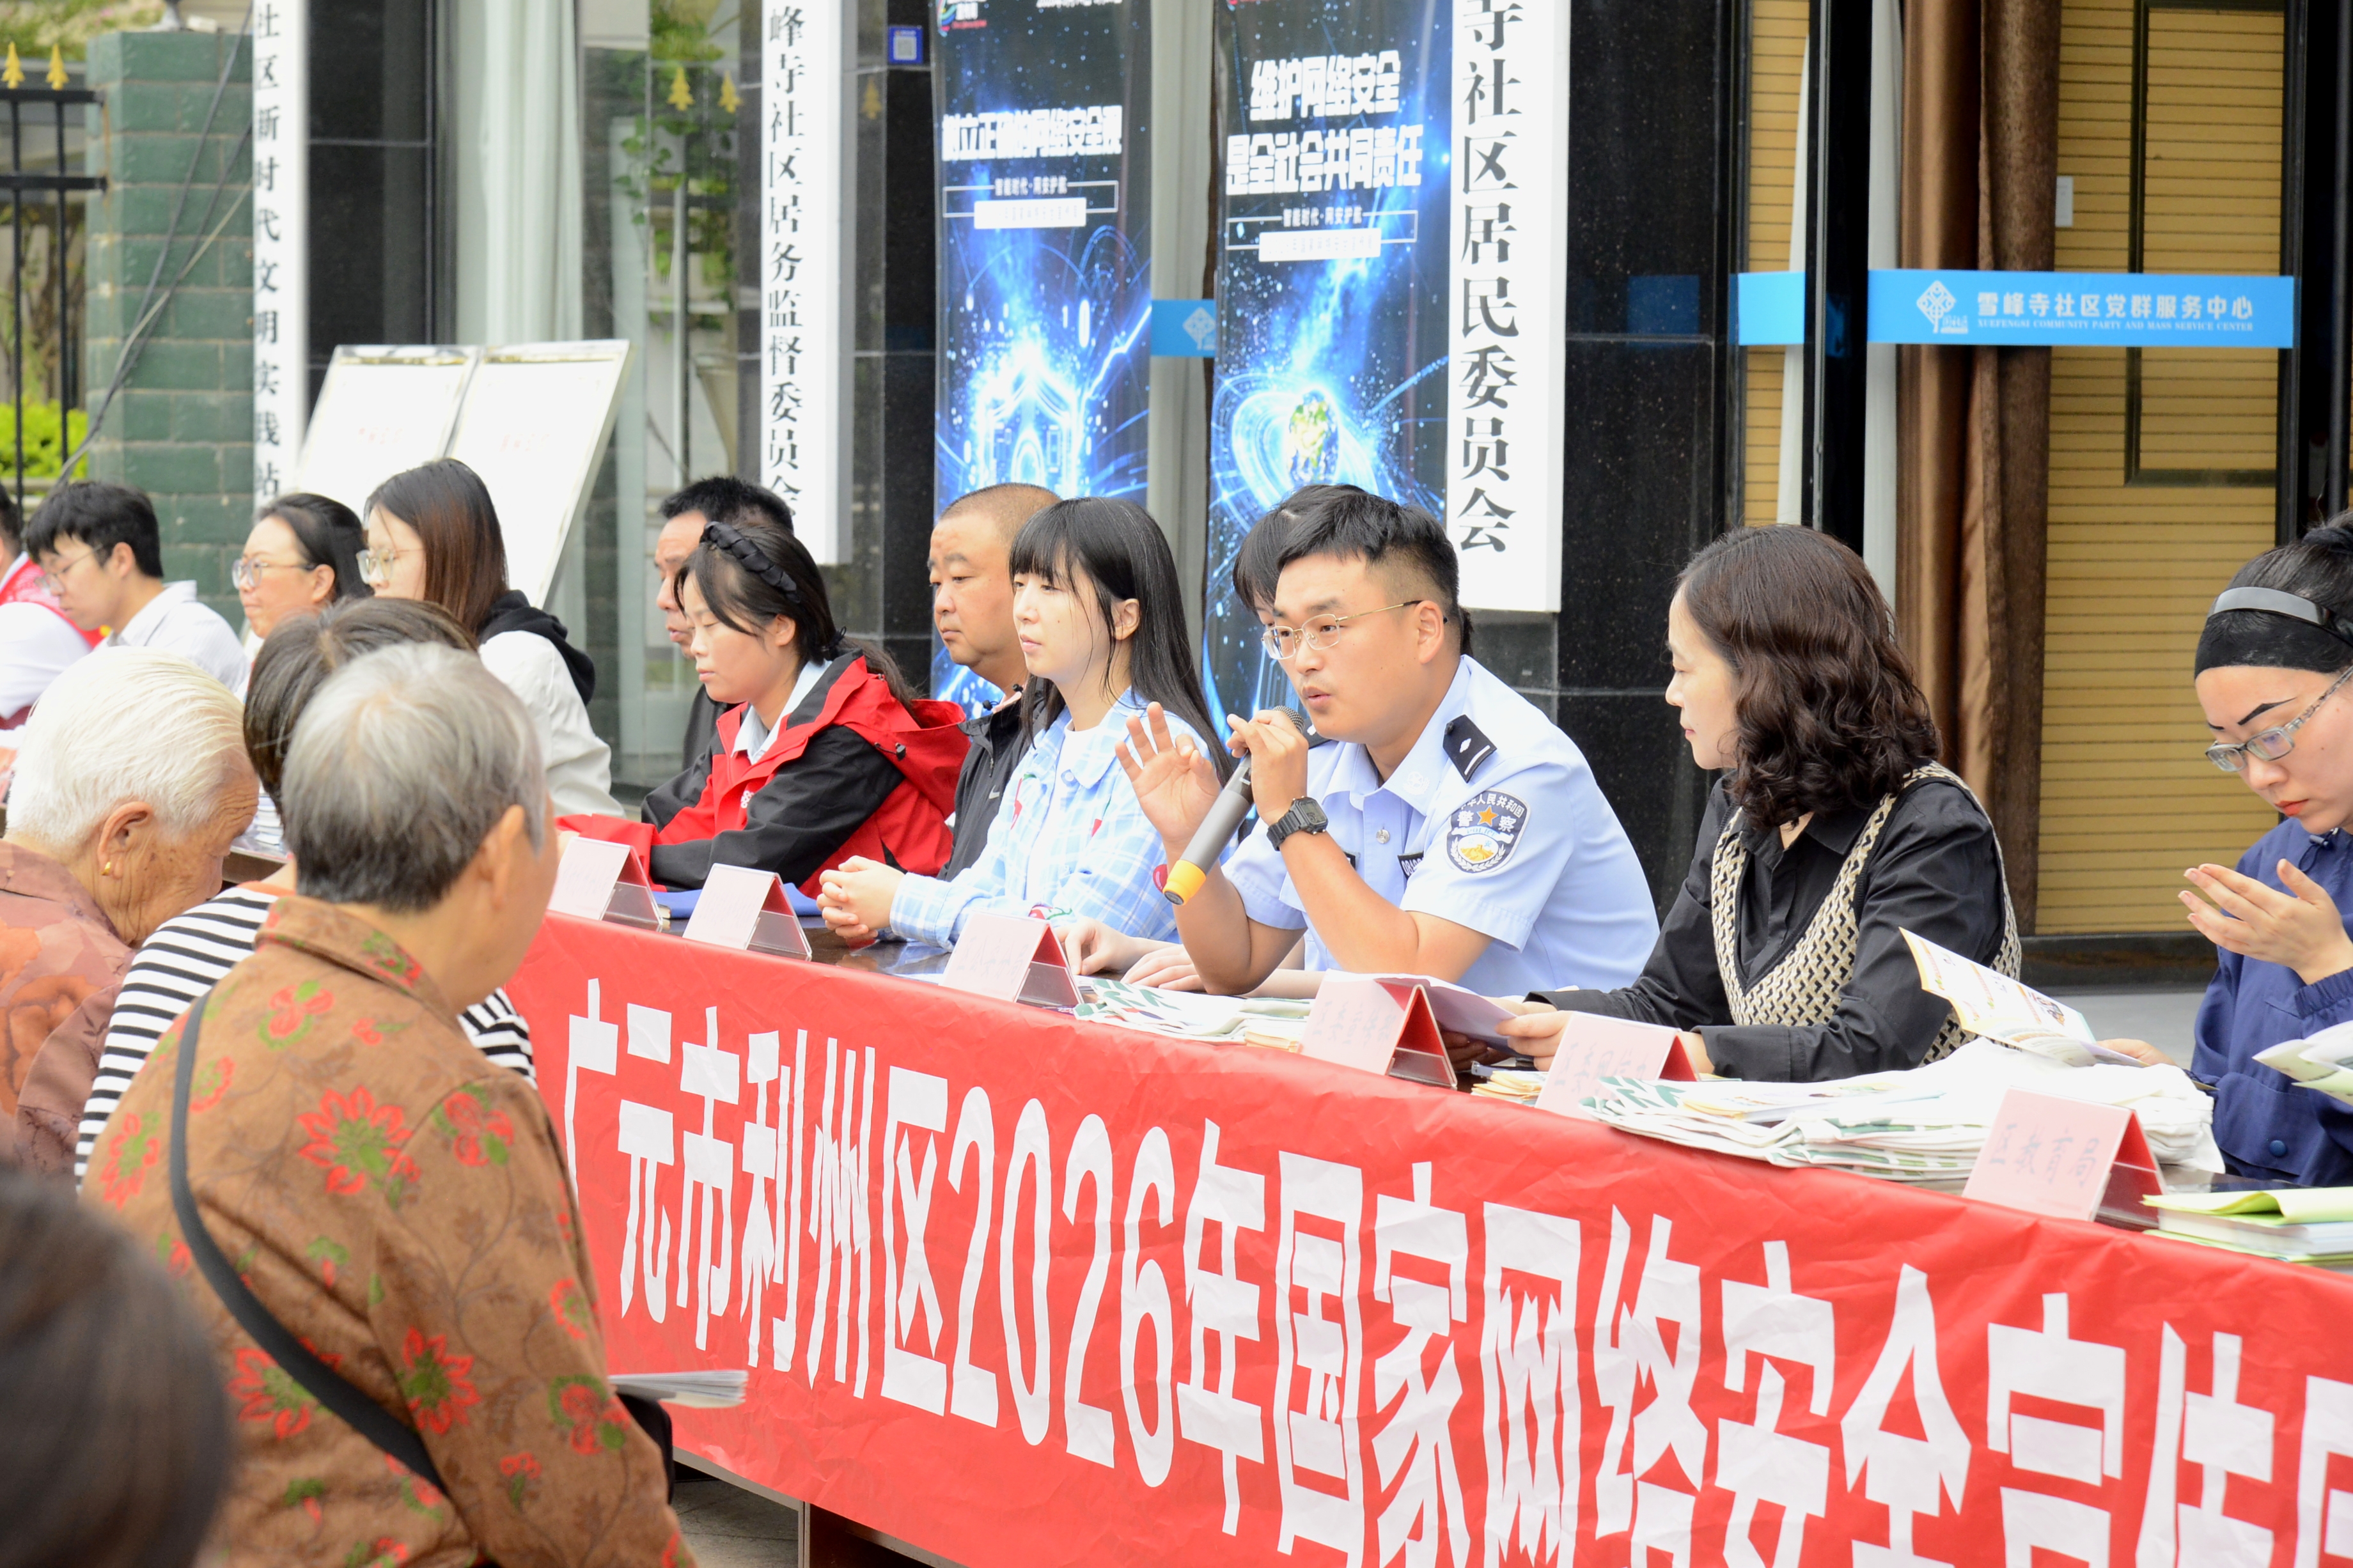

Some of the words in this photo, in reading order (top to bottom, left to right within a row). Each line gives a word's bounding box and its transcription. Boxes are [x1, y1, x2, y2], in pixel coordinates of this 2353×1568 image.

[1250, 50, 1401, 121] 维护网络安全
[1226, 124, 1424, 195] 是全社会共同责任
[1978, 292, 2253, 320] 雪峰寺社区党群服务中心
[2033, 319, 2089, 329] COMMUNITY
[2092, 320, 2121, 330] PARTY
[2125, 321, 2144, 330] AND
[2148, 321, 2172, 330] MASS
[2175, 322, 2214, 331] SERVICE
[2217, 322, 2253, 332] CENTER
[1467, 828, 1497, 837] POLICE
[1990, 1123, 2100, 1188] 区教育局
